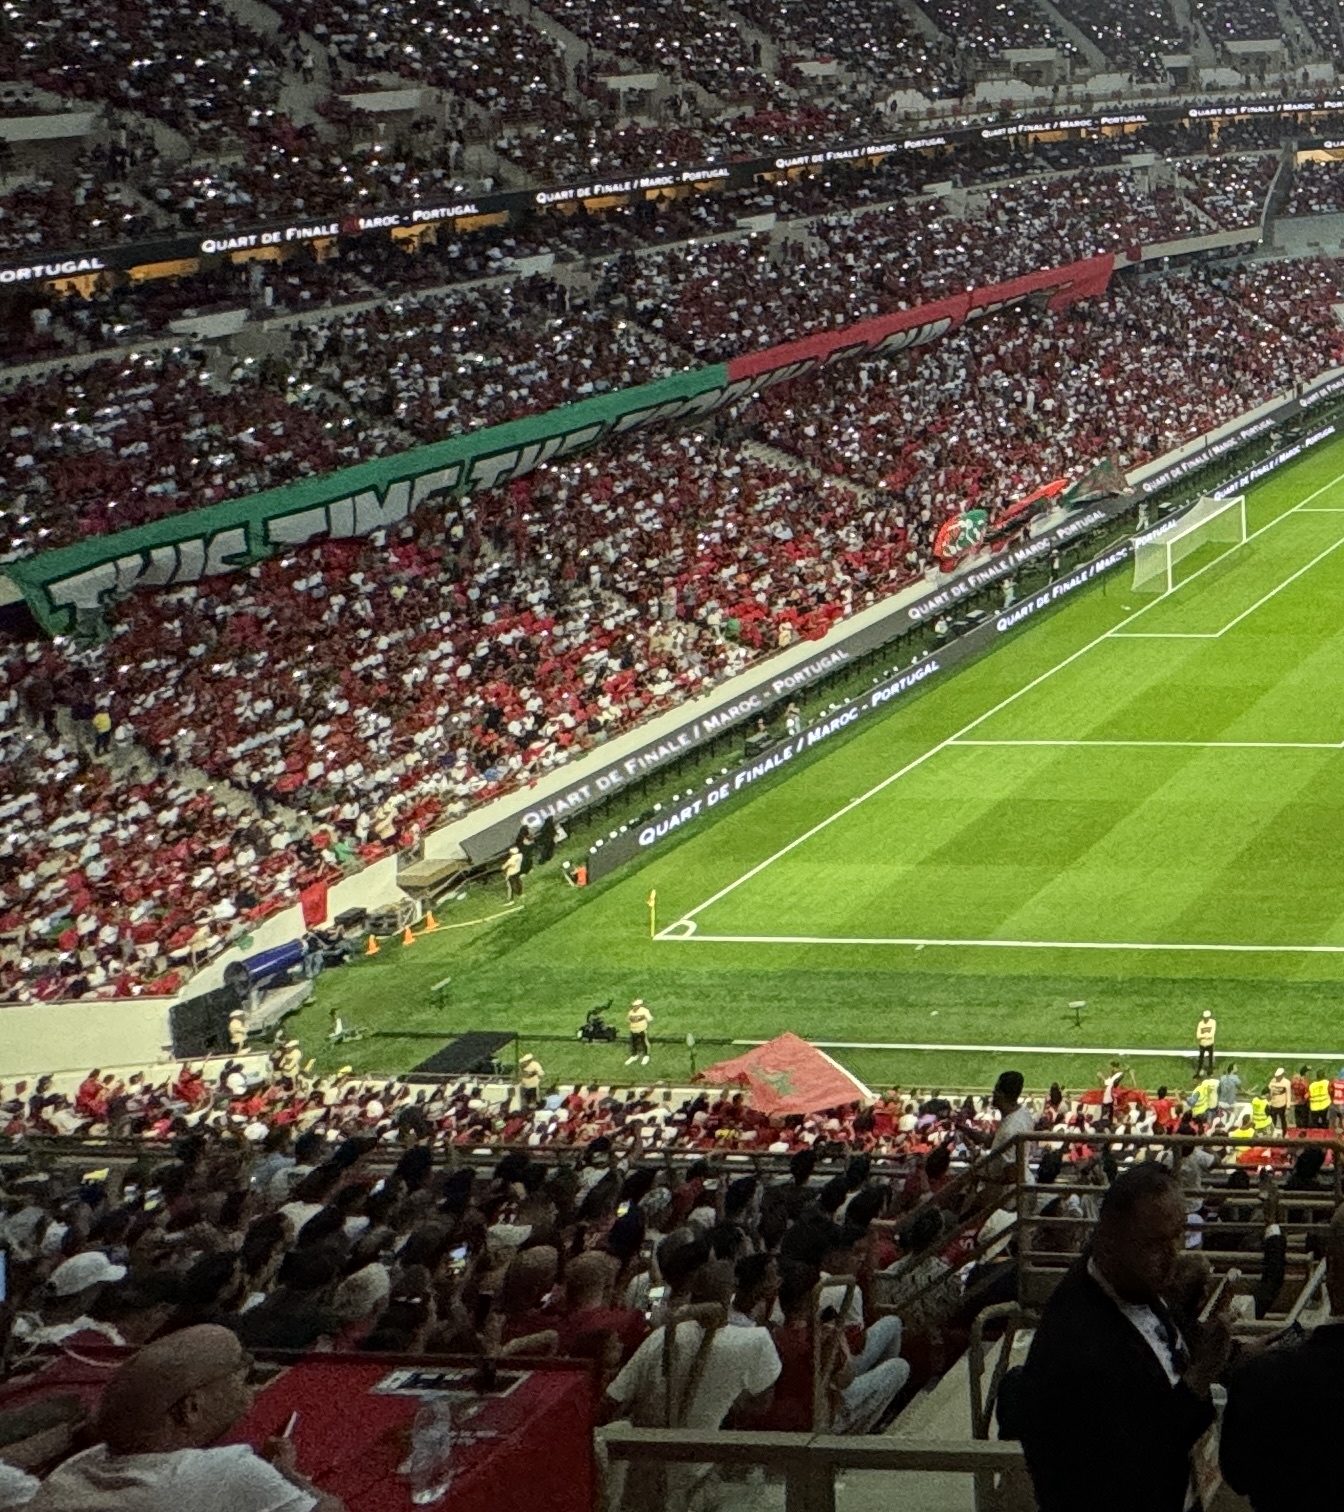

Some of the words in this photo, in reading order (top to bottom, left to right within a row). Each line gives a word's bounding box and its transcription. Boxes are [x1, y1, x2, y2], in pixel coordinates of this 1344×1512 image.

[775, 155, 809, 168] QUART
[812, 153, 824, 163] DE
[827, 148, 859, 161] FINALE
[867, 143, 896, 155] MAROC
[905, 136, 945, 150] PORTUGAL
[536, 187, 574, 202] QUART
[578, 185, 591, 196] DE
[594, 180, 631, 194] FINALE
[640, 174, 673, 188] MAROC
[683, 167, 729, 182] PORTUGAL
[201, 234, 257, 254] QUART
[262, 230, 281, 245] DE
[286, 222, 339, 241] FINALE
[413, 203, 478, 222] PORTUGAL
[908, 592, 949, 619] QUART
[950, 583, 968, 597] DE
[968, 561, 1008, 587] FINALE
[1014, 538, 1051, 560] MAROC
[1056, 510, 1106, 539] PORTUGAL
[996, 601, 1034, 631] QUART
[1036, 592, 1050, 609] DE
[1052, 571, 1088, 598] FINALE
[596, 770, 624, 790] DE
[624, 732, 690, 775] FINALE
[702, 695, 761, 733] MAROC
[771, 648, 849, 695] PORTUGAL
[638, 799, 702, 845] QUART
[706, 787, 730, 805] DE
[734, 745, 792, 790] FINALE
[807, 707, 858, 745] MAROC
[871, 661, 940, 707] PORTUGAL
